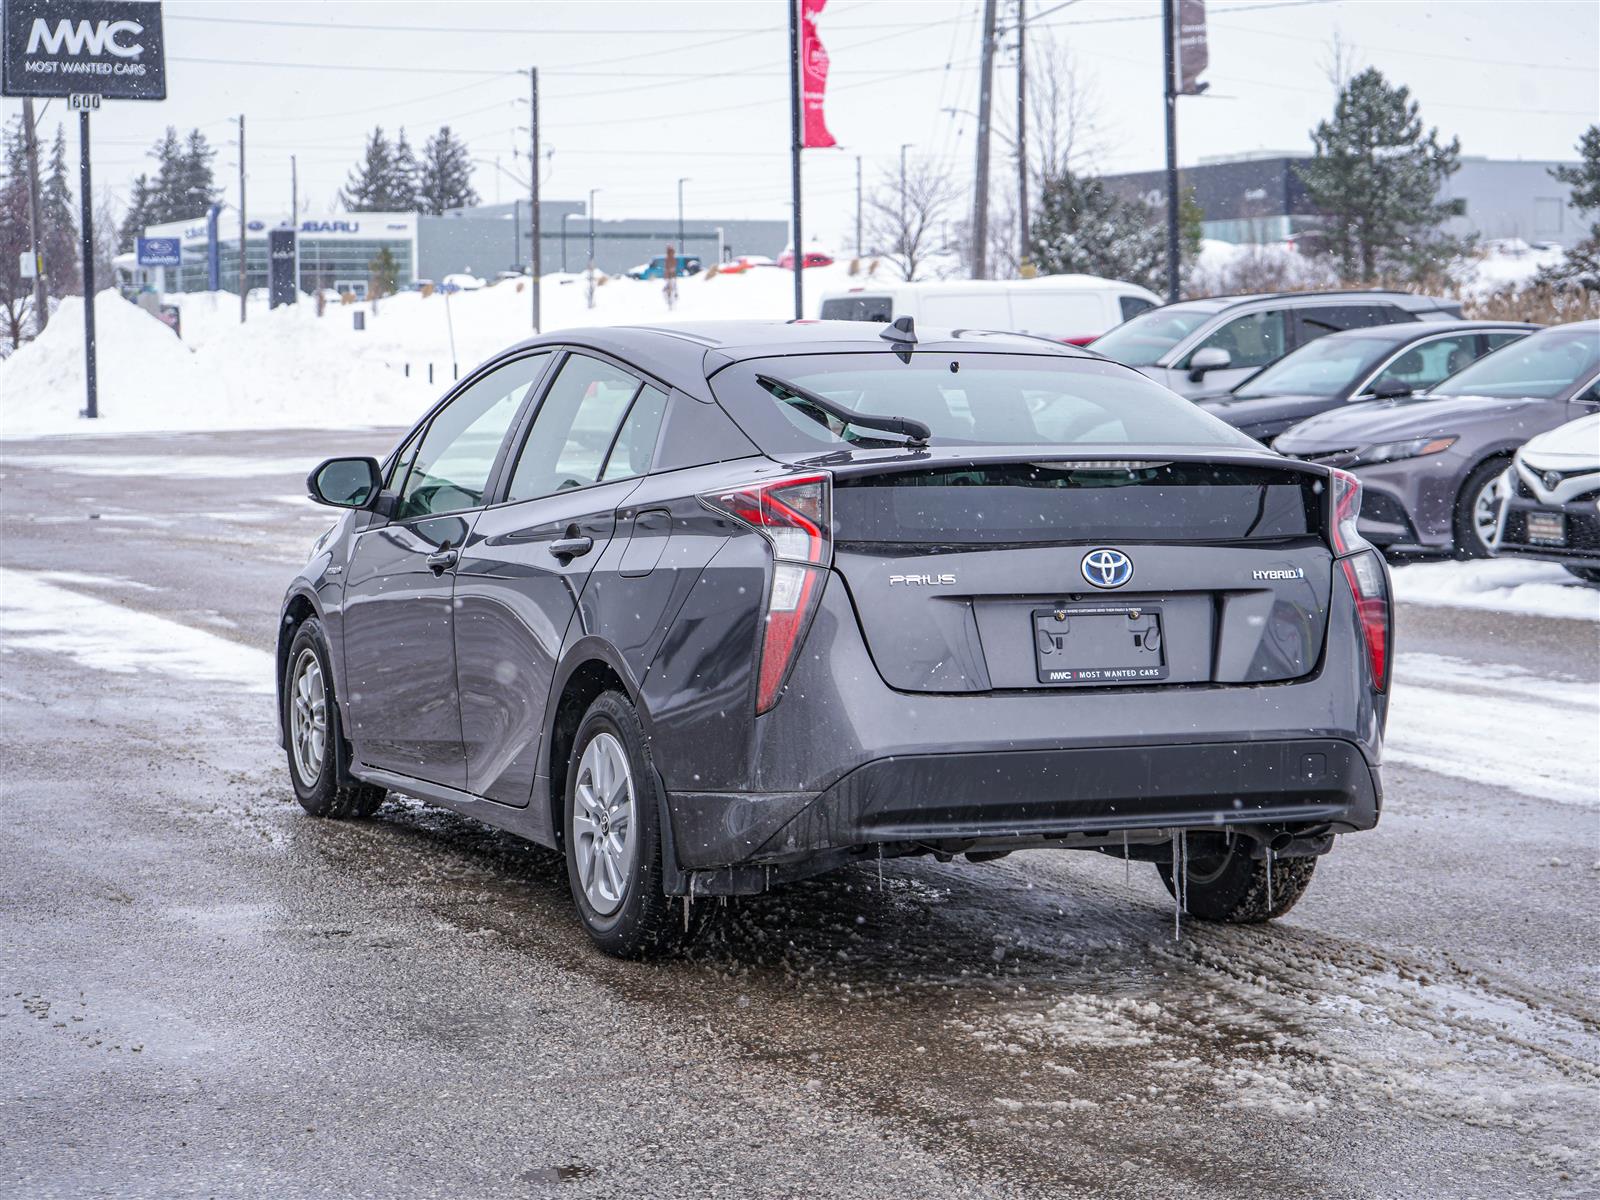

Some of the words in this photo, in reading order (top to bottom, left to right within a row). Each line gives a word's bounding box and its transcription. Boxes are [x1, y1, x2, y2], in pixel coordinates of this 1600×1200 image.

[26, 18, 144, 57] MWC
[25, 61, 59, 73] MOST
[60, 62, 112, 75] WANTED
[114, 63, 146, 76] CARS
[72, 95, 101, 109] 600
[281, 221, 359, 233] UBARU
[889, 574, 957, 586] PRIUS
[1252, 570, 1296, 580] HYBRID
[1079, 671, 1100, 679] MOST
[1104, 669, 1137, 678] WANTED
[1139, 668, 1159, 677] CARS
